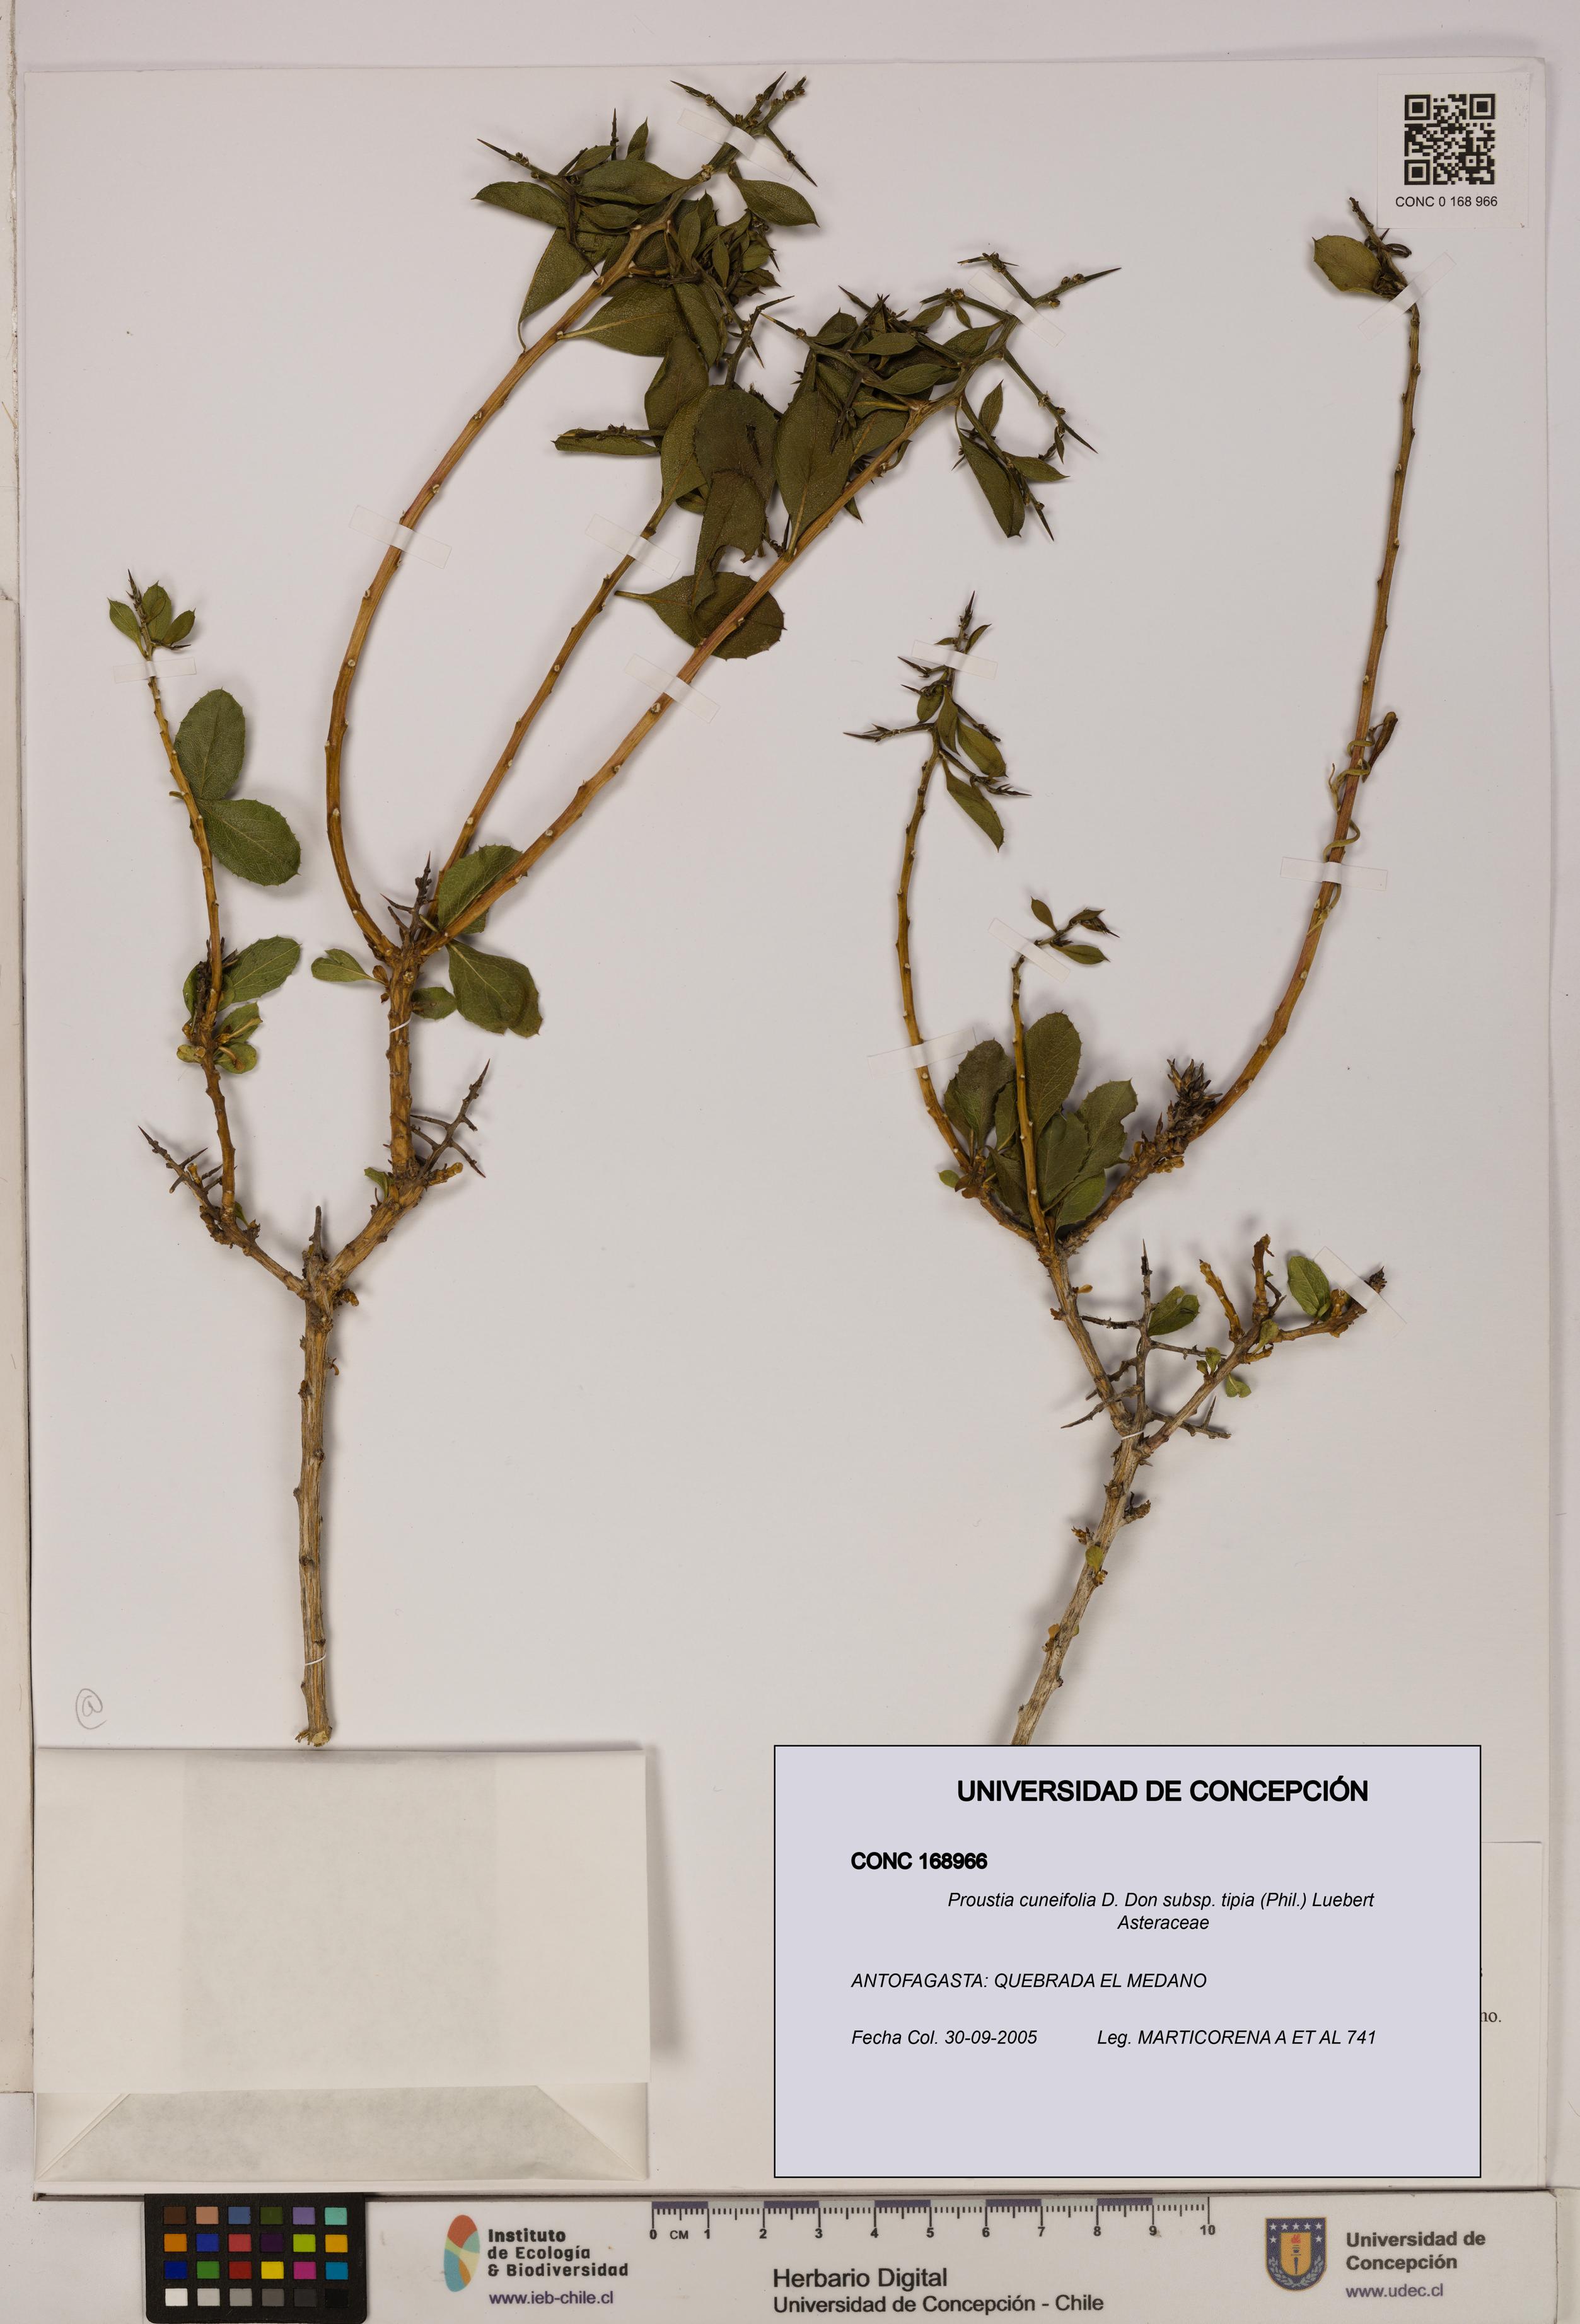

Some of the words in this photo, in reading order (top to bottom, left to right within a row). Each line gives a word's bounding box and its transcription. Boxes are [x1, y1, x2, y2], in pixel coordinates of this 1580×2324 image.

[1395, 196, 1434, 207] CONC
[1439, 196, 1446, 207] 0
[1450, 196, 1472, 207] 168
[1475, 195, 1498, 207] 966
[488, 2228, 566, 2243] Instituto
[649, 2229, 658, 2240] 0
[670, 2229, 689, 2240] CM
[704, 2228, 711, 2240] 1
[759, 2228, 767, 2239] 2
[815, 2228, 823, 2239] 3
[870, 2228, 879, 2238] 4
[926, 2228, 934, 2238] 5
[982, 2227, 990, 2238] 6
[1038, 2226, 1045, 2237] 7
[1093, 2226, 1101, 2236] 8
[1149, 2226, 1158, 2236] 9
[1200, 2225, 1216, 2235] 10
[1346, 2231, 1458, 2248] Universidad
[1463, 2231, 1486, 2246] de
[487, 2246, 508, 2260] de
[515, 2245, 591, 2262] Ecología
[506, 2261, 629, 2277] Biodiversidad
[1345, 2253, 1458, 2274] Concepción
[774, 2268, 870, 2288] Herbario
[878, 2267, 947, 2291] Digital
[489, 2290, 613, 2304] www.ieb-chile.cl
[1345, 2282, 1443, 2298] www.udec.cl
[774, 2296, 886, 2313] Universidad
[892, 2296, 917, 2313] de
[922, 2294, 1035, 2316] Concepción
[1055, 2294, 1104, 2311] Chile
